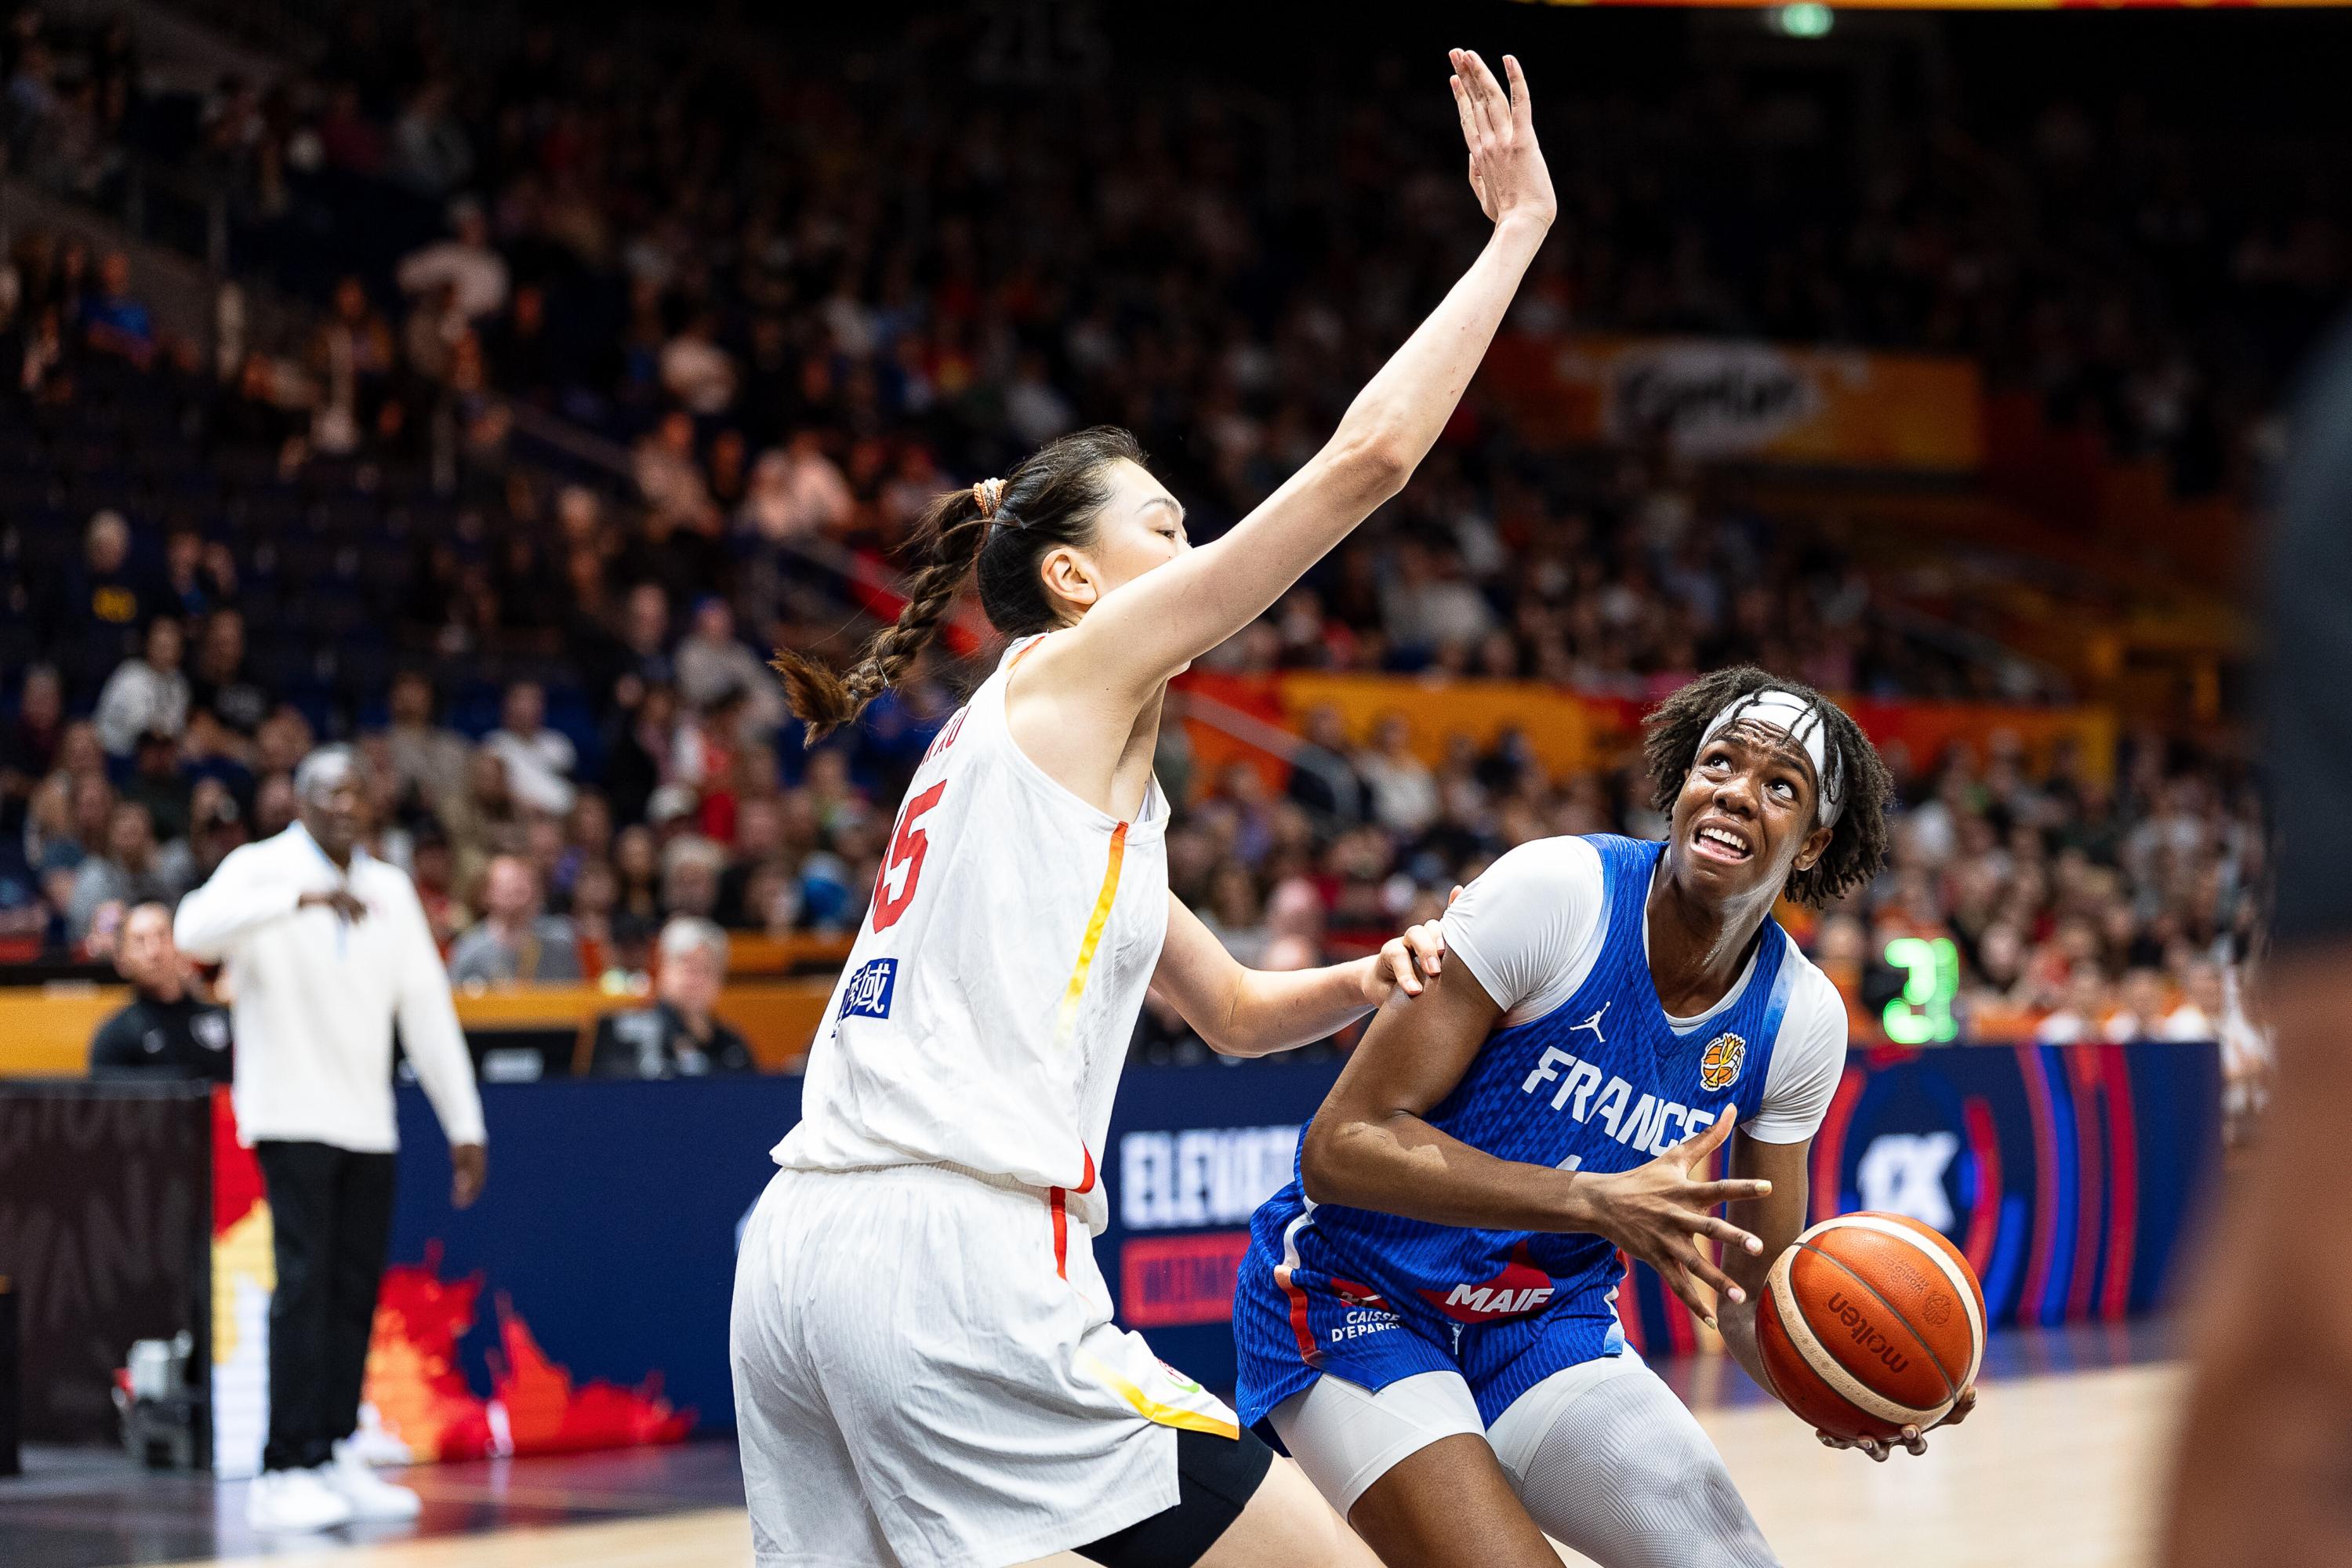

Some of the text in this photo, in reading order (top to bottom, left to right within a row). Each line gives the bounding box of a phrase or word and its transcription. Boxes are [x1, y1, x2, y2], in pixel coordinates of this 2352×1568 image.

[1522, 1046, 1715, 1158] FRANCE
[1445, 1283, 1555, 1312] MAIF
[1346, 1311, 1400, 1324] CAISSE
[1331, 1322, 1399, 1343] D'EPARG
[1828, 1292, 1909, 1374] molten
